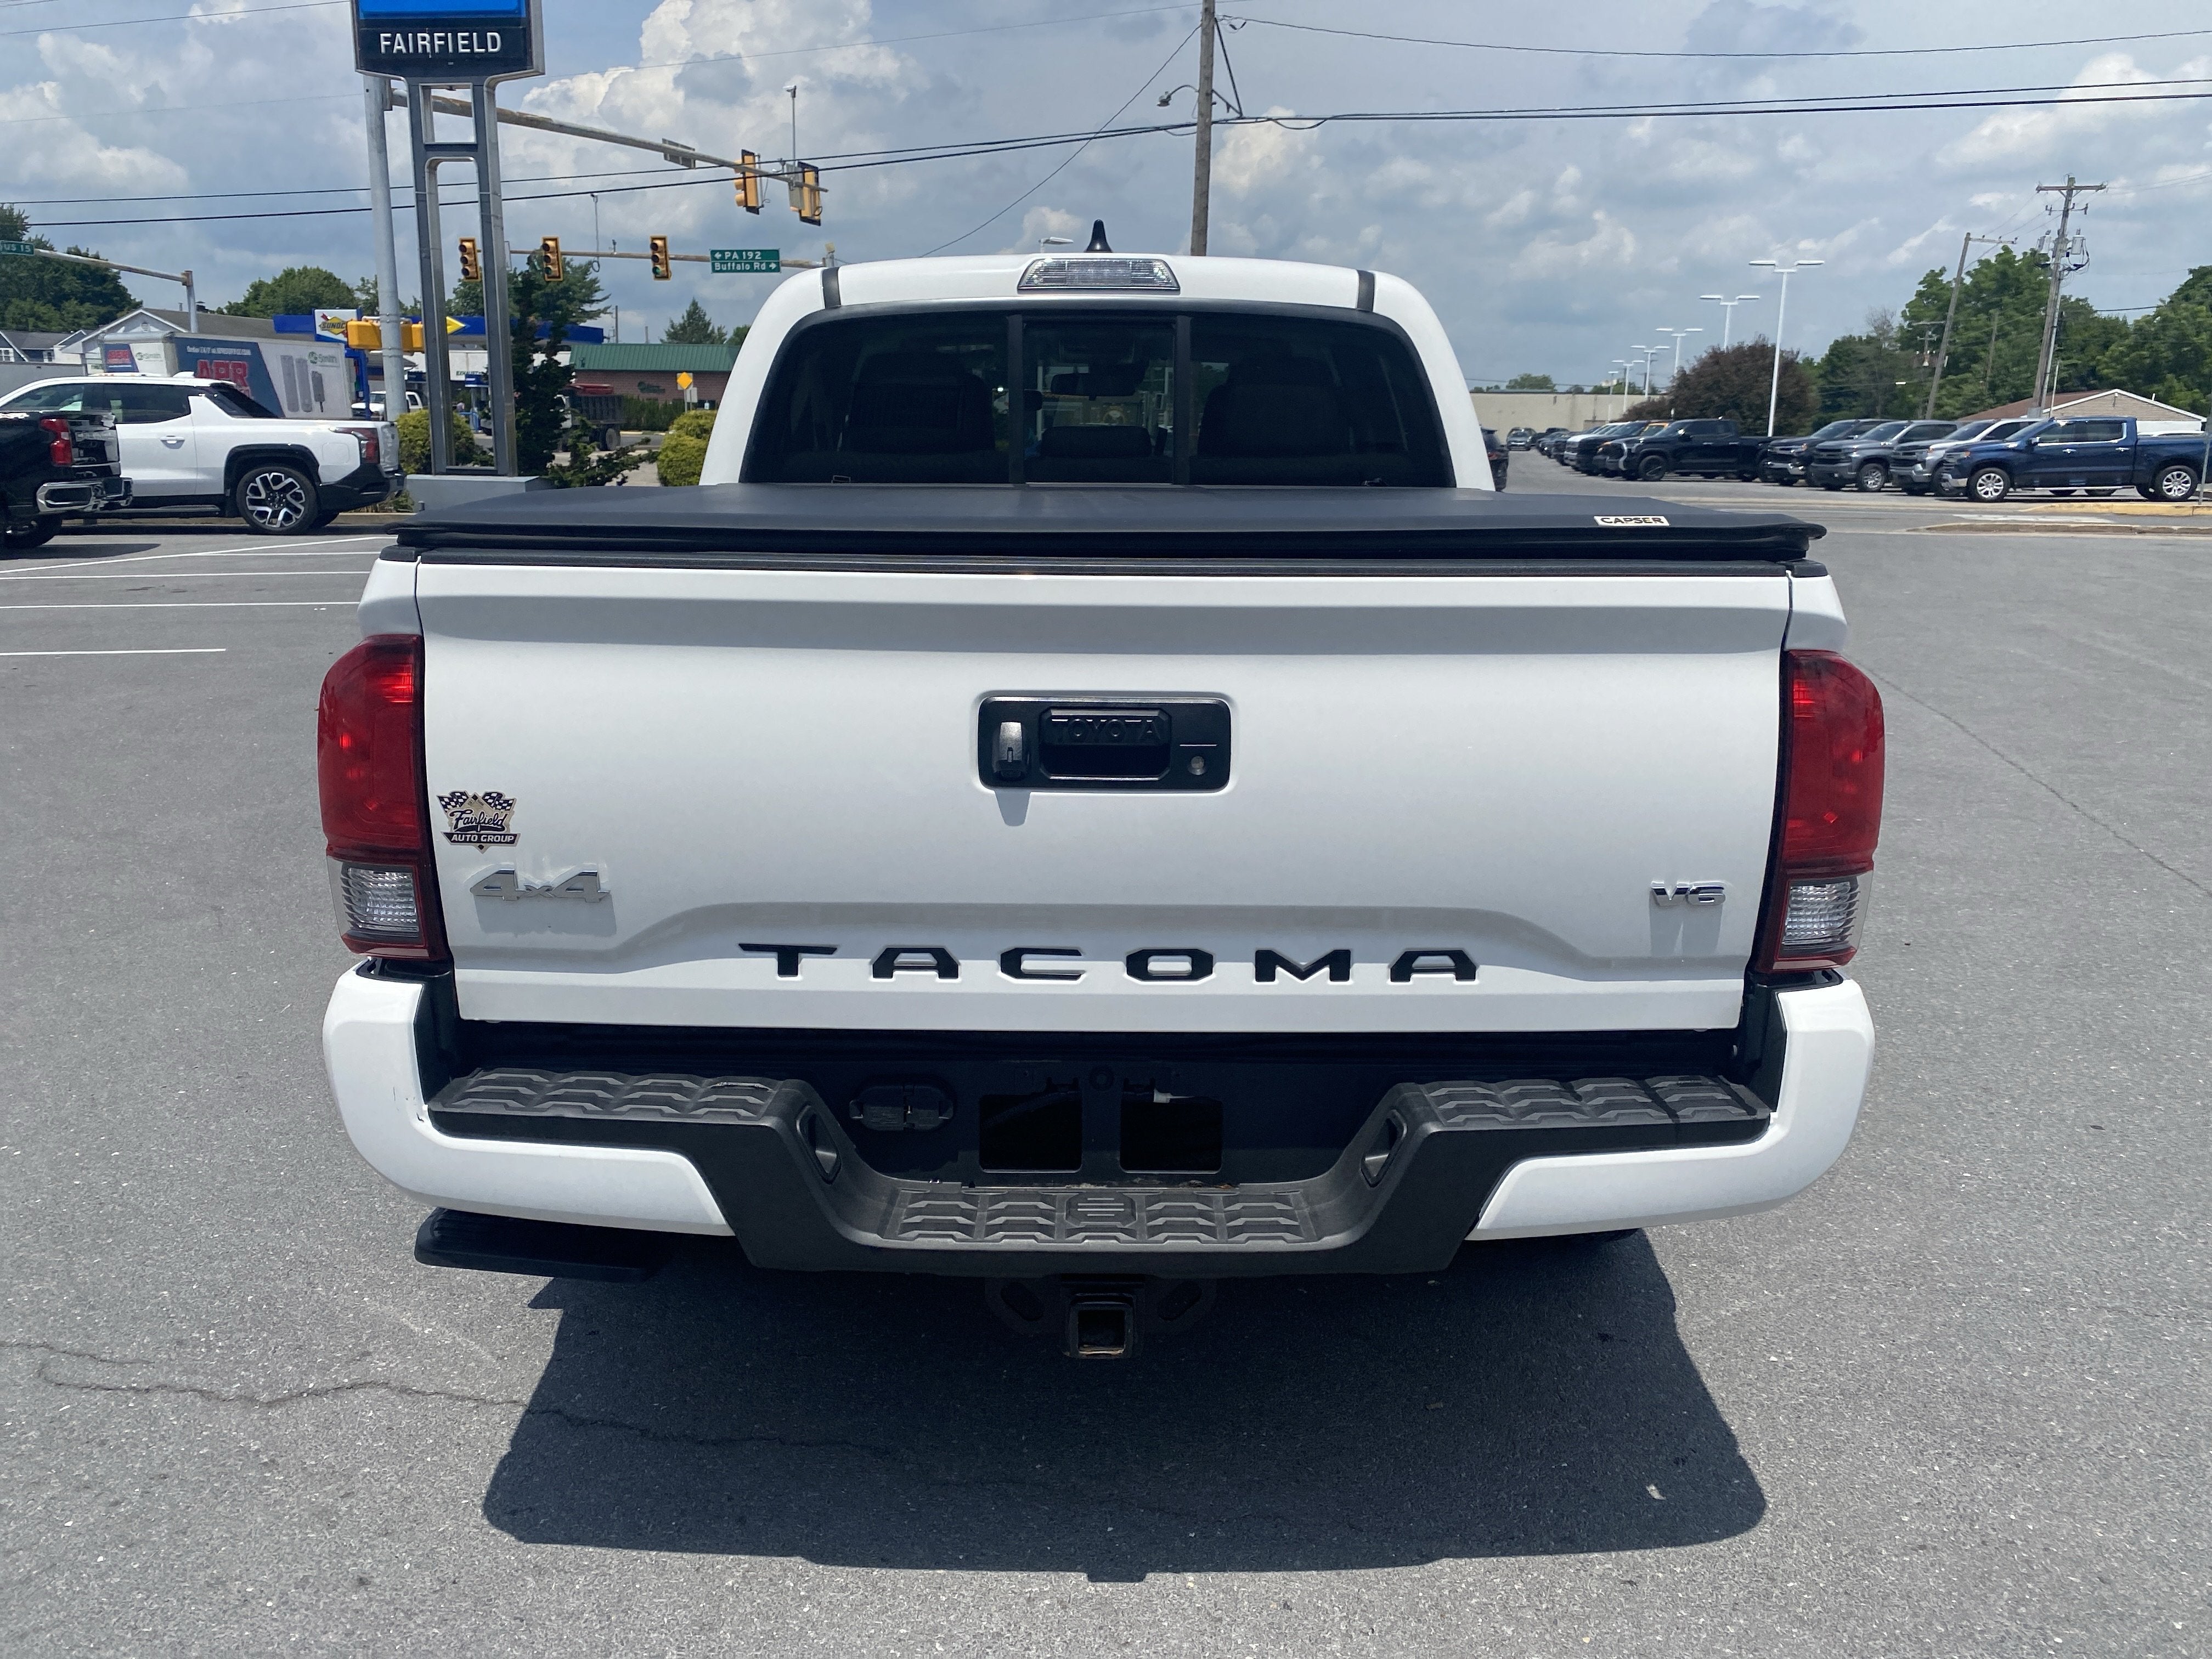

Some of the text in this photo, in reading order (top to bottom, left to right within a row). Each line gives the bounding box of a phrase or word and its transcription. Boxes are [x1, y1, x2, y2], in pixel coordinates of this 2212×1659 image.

[380, 32, 502, 54] FAIRFIELD
[21, 244, 31, 252] 15
[724, 251, 761, 259] PA 192
[714, 262, 766, 270] Buffalo Rd
[1051, 718, 1161, 741] TOYOTA
[449, 809, 508, 832] Fairfield
[451, 834, 478, 842] AUTO
[1649, 885, 1726, 906] V6
[738, 943, 1477, 983] TACOMA
